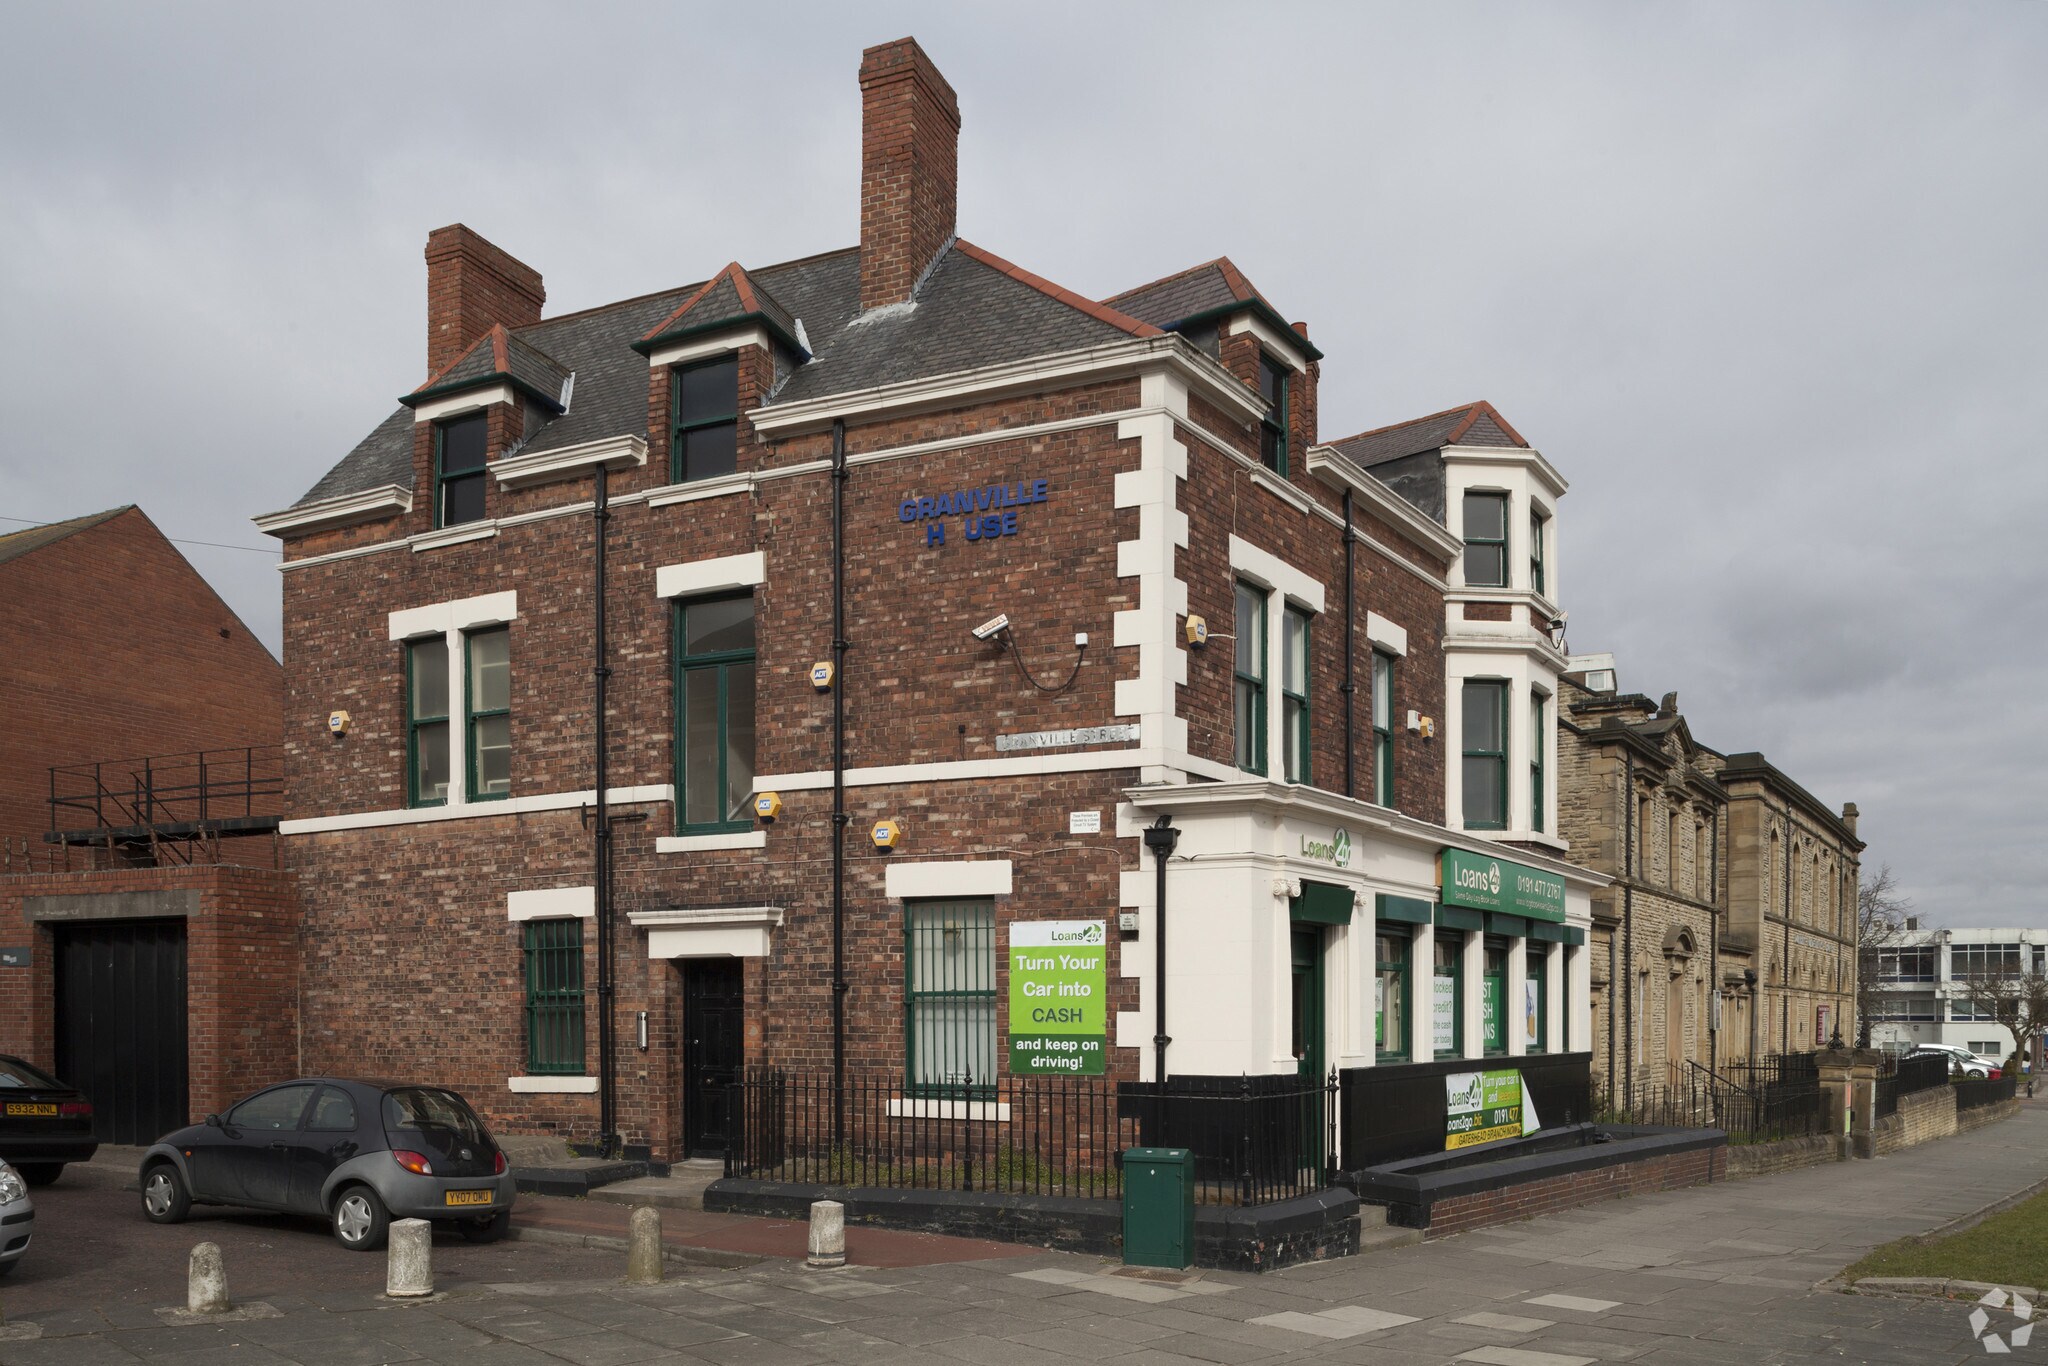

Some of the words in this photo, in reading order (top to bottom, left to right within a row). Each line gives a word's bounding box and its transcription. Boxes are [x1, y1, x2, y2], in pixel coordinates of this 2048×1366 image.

[899, 479, 1048, 523] GRANVILLE
[815, 669, 826, 679] ADT
[759, 800, 770, 809] ADT
[876, 829, 888, 838] ADT
[1517, 875, 1533, 894] 0191
[1534, 880, 1546, 897] 477
[1547, 882, 1561, 900] 2767
[1016, 955, 1055, 970] Turn
[1059, 954, 1099, 970] Your
[1023, 981, 1054, 997] Car
[1058, 981, 1092, 997] into
[1032, 1008, 1083, 1023] CASH
[1484, 1023, 1495, 1040] NS
[1016, 1038, 1041, 1050] and
[1045, 1038, 1078, 1052] keep
[1081, 1041, 1099, 1051] on
[1031, 1056, 1083, 1070] driving!
[1482, 1075, 1495, 1087] Turn
[1495, 1075, 1507, 1089] your
[1488, 1091, 1497, 1103] and
[8, 1104, 35, 1114] S932
[37, 1104, 56, 1114] NNL
[1494, 1109, 1508, 1124] 0191
[1509, 1107, 1519, 1121] 477
[1458, 1131, 1486, 1146] GATESHEAD
[1487, 1127, 1506, 1140] BRANCH
[450, 1192, 471, 1203] YY07
[473, 1191, 489, 1202] OMU
